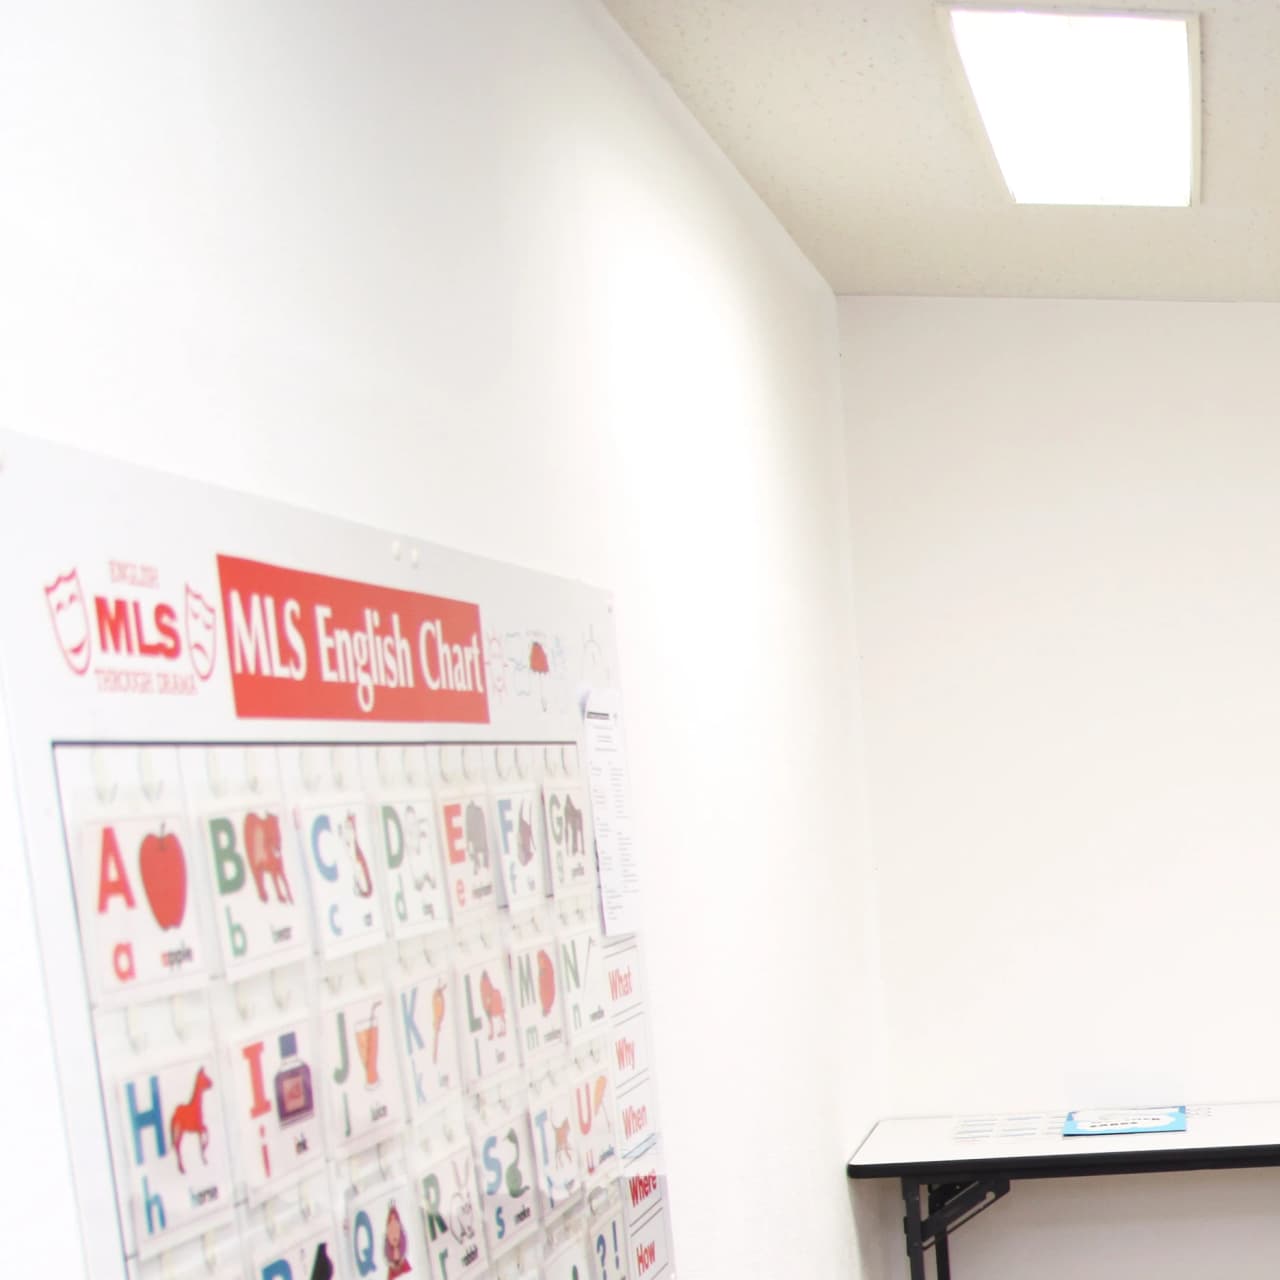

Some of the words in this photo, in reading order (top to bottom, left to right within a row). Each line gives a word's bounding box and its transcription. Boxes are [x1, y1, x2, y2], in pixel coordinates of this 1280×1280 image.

[94, 595, 182, 661] MLS
[229, 588, 306, 682] MLS
[318, 603, 414, 713] English
[420, 618, 485, 696] Chart
[311, 814, 339, 882] C
[382, 805, 404, 869] D
[443, 803, 466, 865] E
[498, 799, 513, 854] F
[549, 794, 563, 846] G
[98, 826, 136, 915] A
[210, 817, 246, 896] B
[329, 903, 342, 936] c
[394, 874, 408, 922] d
[225, 905, 247, 957] b
[113, 941, 136, 982] a
[518, 952, 536, 1008] M
[562, 940, 580, 992] N
[608, 965, 632, 1000] What
[401, 987, 425, 1056] K
[464, 974, 483, 1032] L
[334, 1012, 349, 1085] J
[615, 1037, 635, 1071] Why
[242, 1041, 271, 1120] I
[577, 1082, 592, 1135] U
[126, 1075, 166, 1166] H
[535, 1110, 548, 1166] T
[622, 1104, 647, 1139] When
[259, 1124, 270, 1178] i
[483, 1136, 502, 1196] S
[142, 1175, 166, 1236] h
[422, 1173, 448, 1242] R
[629, 1168, 657, 1208] Where
[354, 1210, 376, 1277] Q
[496, 1206, 505, 1240] s
[612, 1220, 619, 1270] !
[636, 1240, 655, 1276] How
